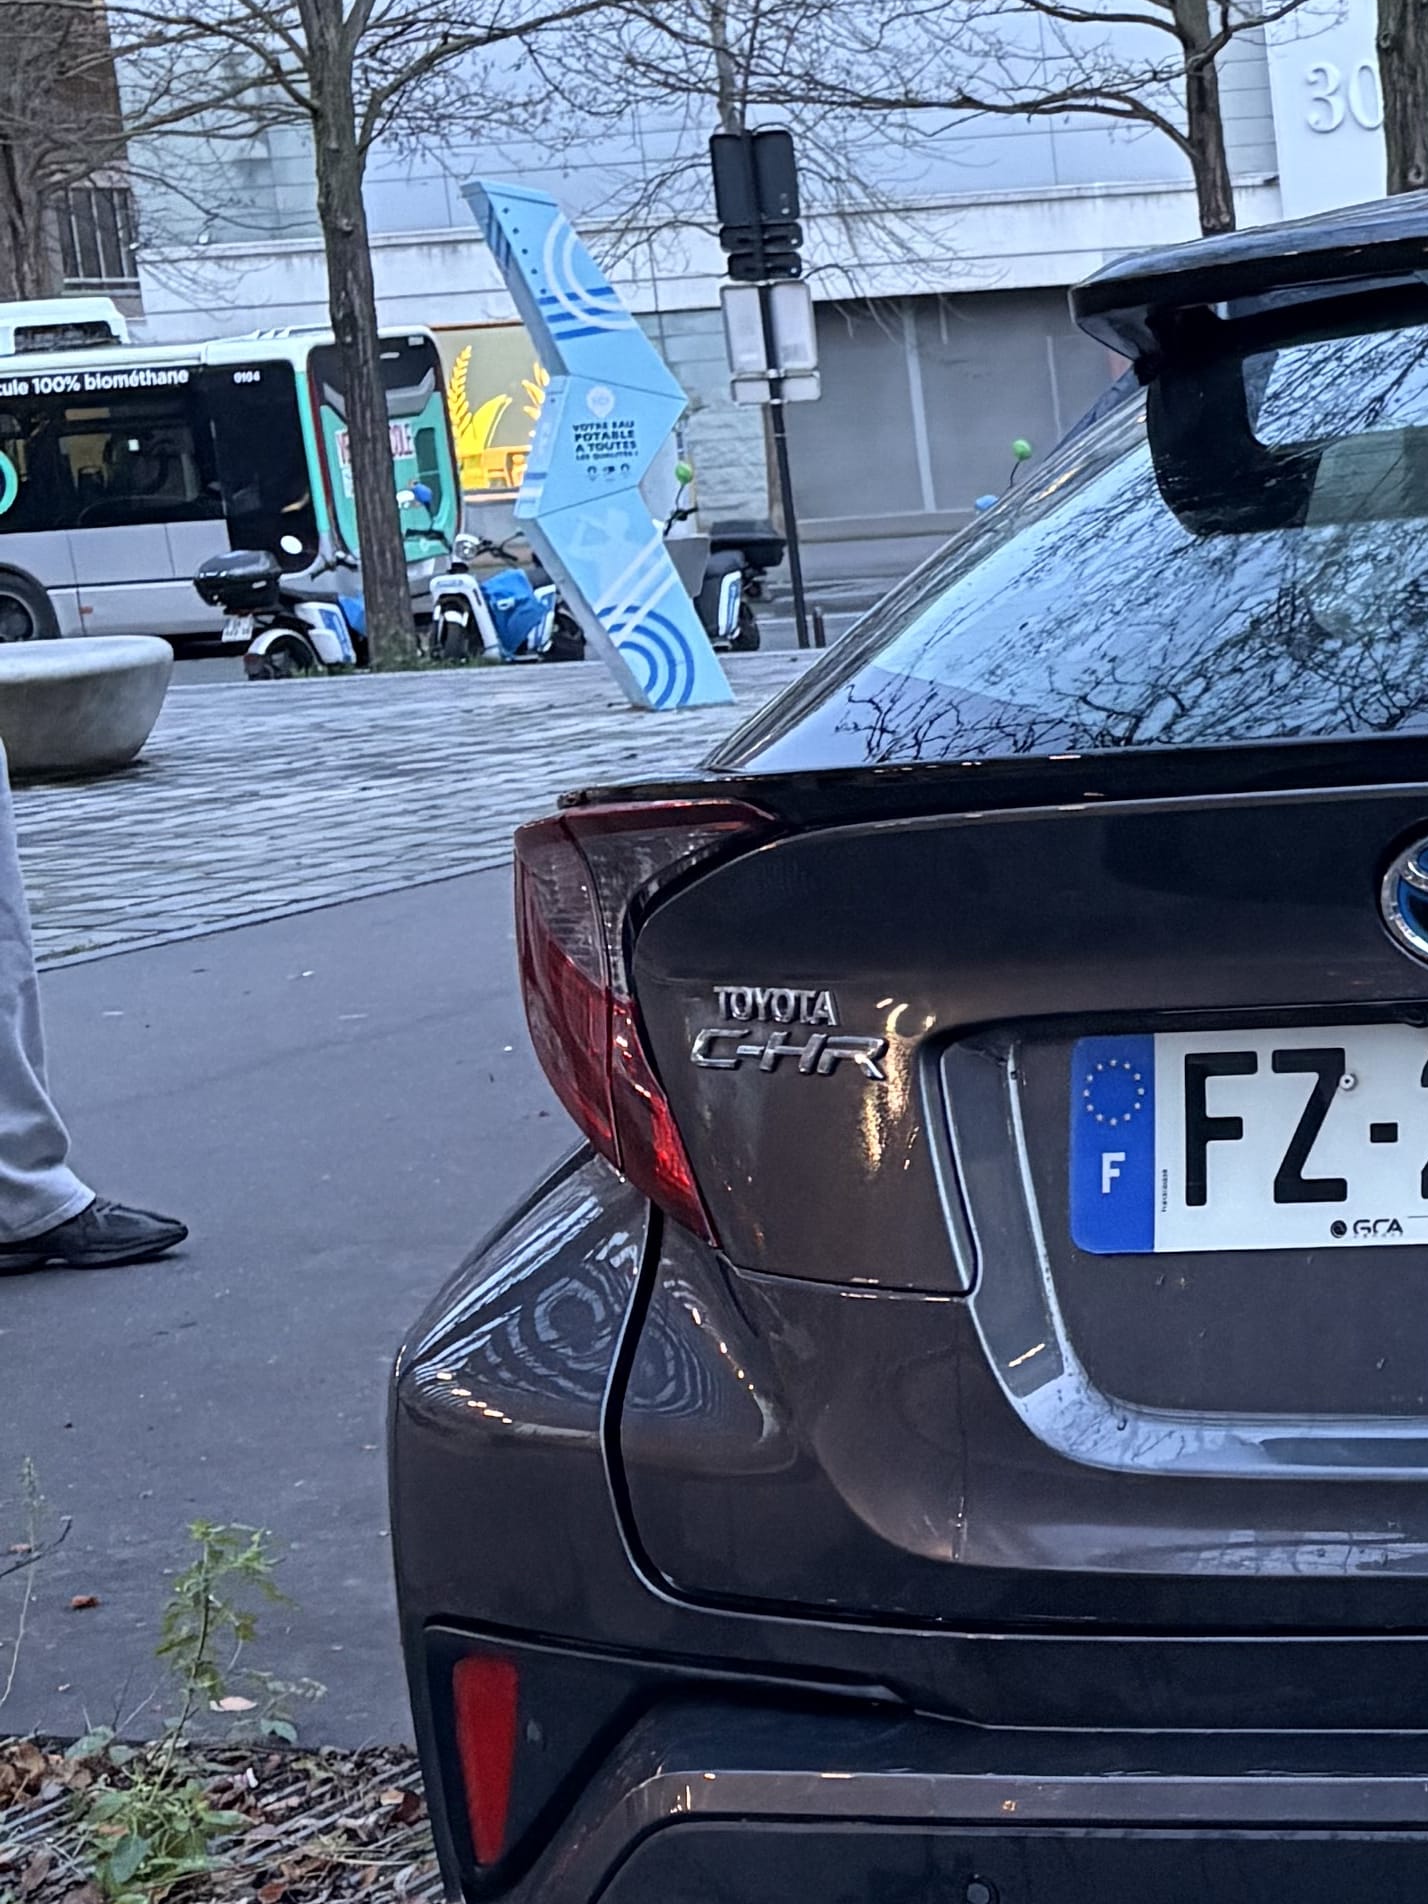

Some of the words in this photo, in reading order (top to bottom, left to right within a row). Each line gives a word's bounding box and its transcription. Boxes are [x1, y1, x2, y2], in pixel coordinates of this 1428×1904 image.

[1304, 60, 1385, 134] 30
[32, 374, 80, 394] 100%
[84, 369, 189, 391] biométhane
[573, 421, 608, 432] VOTRE
[612, 420, 634, 429] EAU
[575, 429, 635, 442] POTABLE
[587, 440, 636, 451] TOUTES
[713, 986, 838, 1026] TOYOTA
[690, 1028, 885, 1080] C-HR
[1102, 1152, 1126, 1194] F
[1353, 1219, 1403, 1234] GCA
